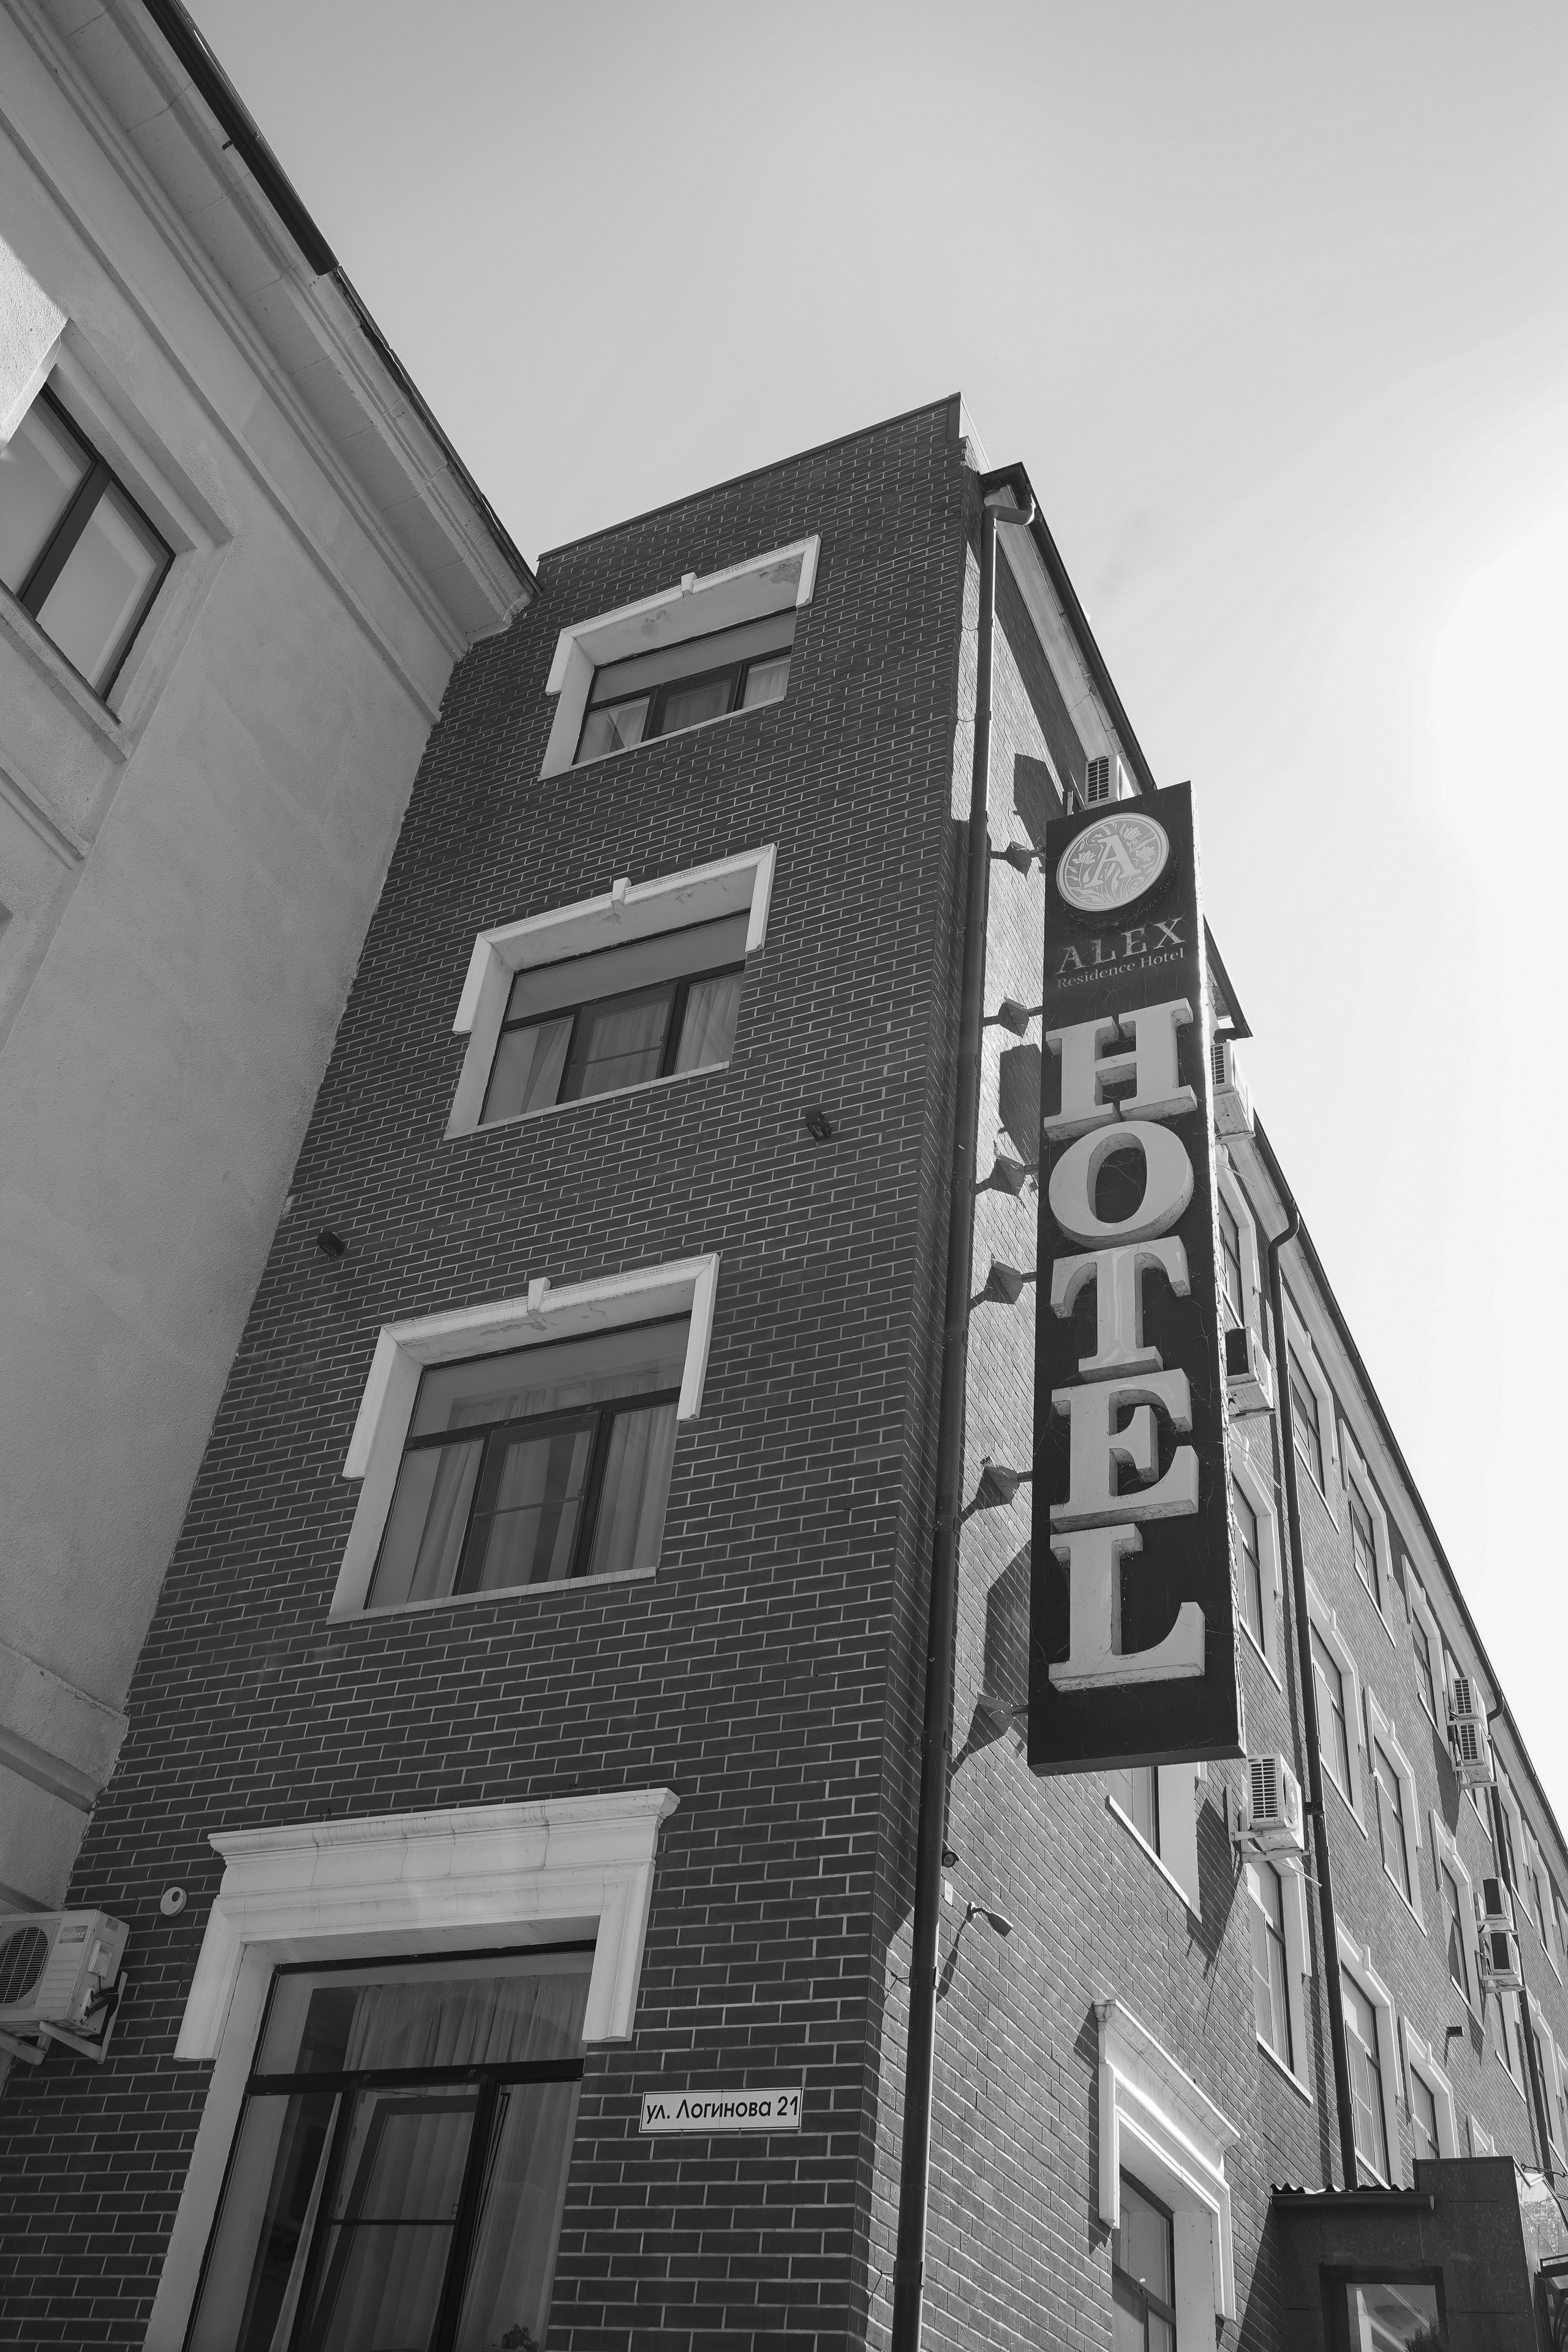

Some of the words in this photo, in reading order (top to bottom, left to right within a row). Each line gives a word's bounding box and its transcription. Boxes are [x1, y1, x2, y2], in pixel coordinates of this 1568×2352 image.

[1083, 834, 1142, 889] A
[1055, 918, 1186, 974] ALEX
[1057, 962, 1136, 988] Residence
[1141, 948, 1185, 969] Hotel
[1044, 998, 1205, 1692] HOTEL
[646, 2105, 670, 2124] ул.
[676, 2099, 771, 2119] Логинова
[777, 2096, 798, 2116] 21
